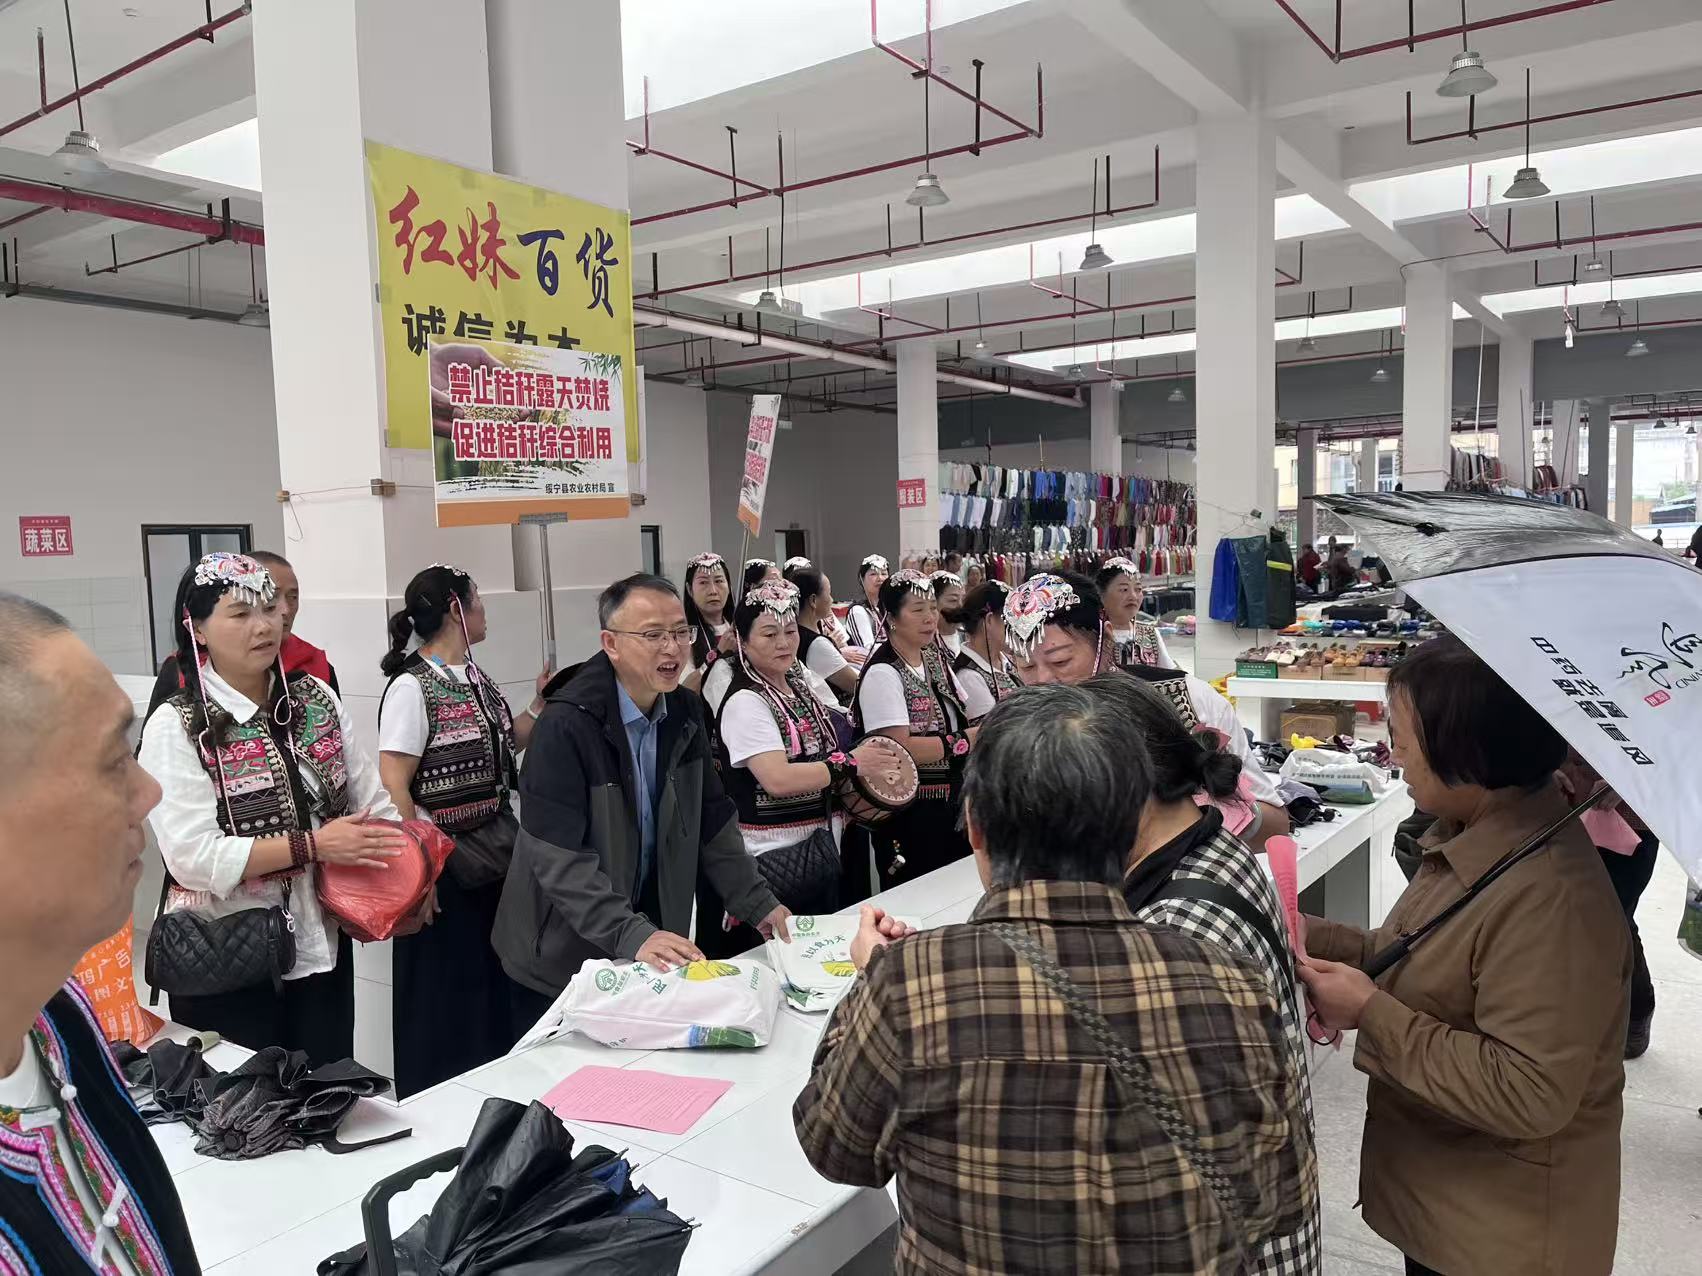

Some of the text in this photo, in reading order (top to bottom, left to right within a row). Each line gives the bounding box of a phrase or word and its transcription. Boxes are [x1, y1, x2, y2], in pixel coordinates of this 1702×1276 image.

[389, 185, 619, 319] 红妹百货
[448, 363, 611, 412] 禁止秸秆露天焚烧
[452, 420, 613, 461] 促进秸秆综合利用
[25, 527, 69, 553] 蔬菜区
[1530, 637, 1629, 718] 中药去屑
[1552, 679, 1655, 765] 就是追风
